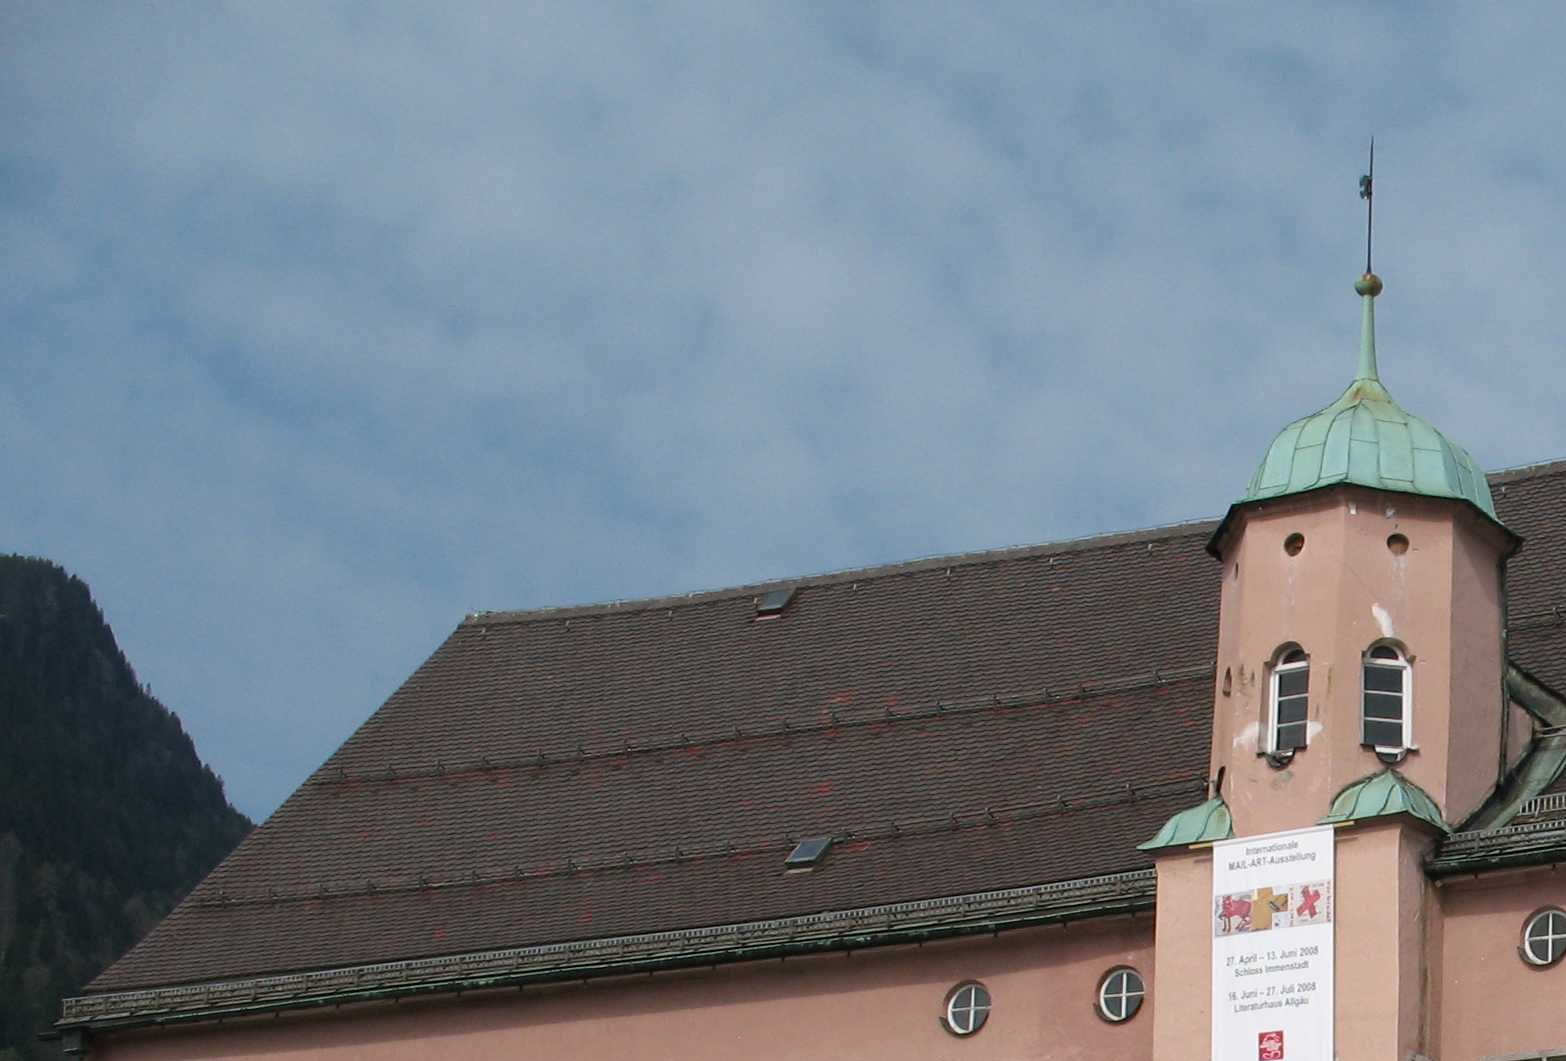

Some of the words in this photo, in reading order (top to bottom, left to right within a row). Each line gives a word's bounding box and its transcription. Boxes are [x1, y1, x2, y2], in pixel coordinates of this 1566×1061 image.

[1245, 839, 1298, 856] Internationale
[1228, 852, 1317, 871] MAIL-ART-Ausstellung
[1239, 953, 1258, 964] April
[1279, 948, 1298, 959] Juni
[1299, 946, 1319, 957] 2008
[1234, 967, 1263, 977] Schloss
[1265, 961, 1309, 973] Immenstadt
[1240, 989, 1258, 1000] Juni
[1280, 983, 1295, 995] Juli
[1296, 981, 1317, 993] 2008
[1234, 1000, 1282, 1013] Literaturhaus
[1284, 996, 1309, 1008] Allgäu
